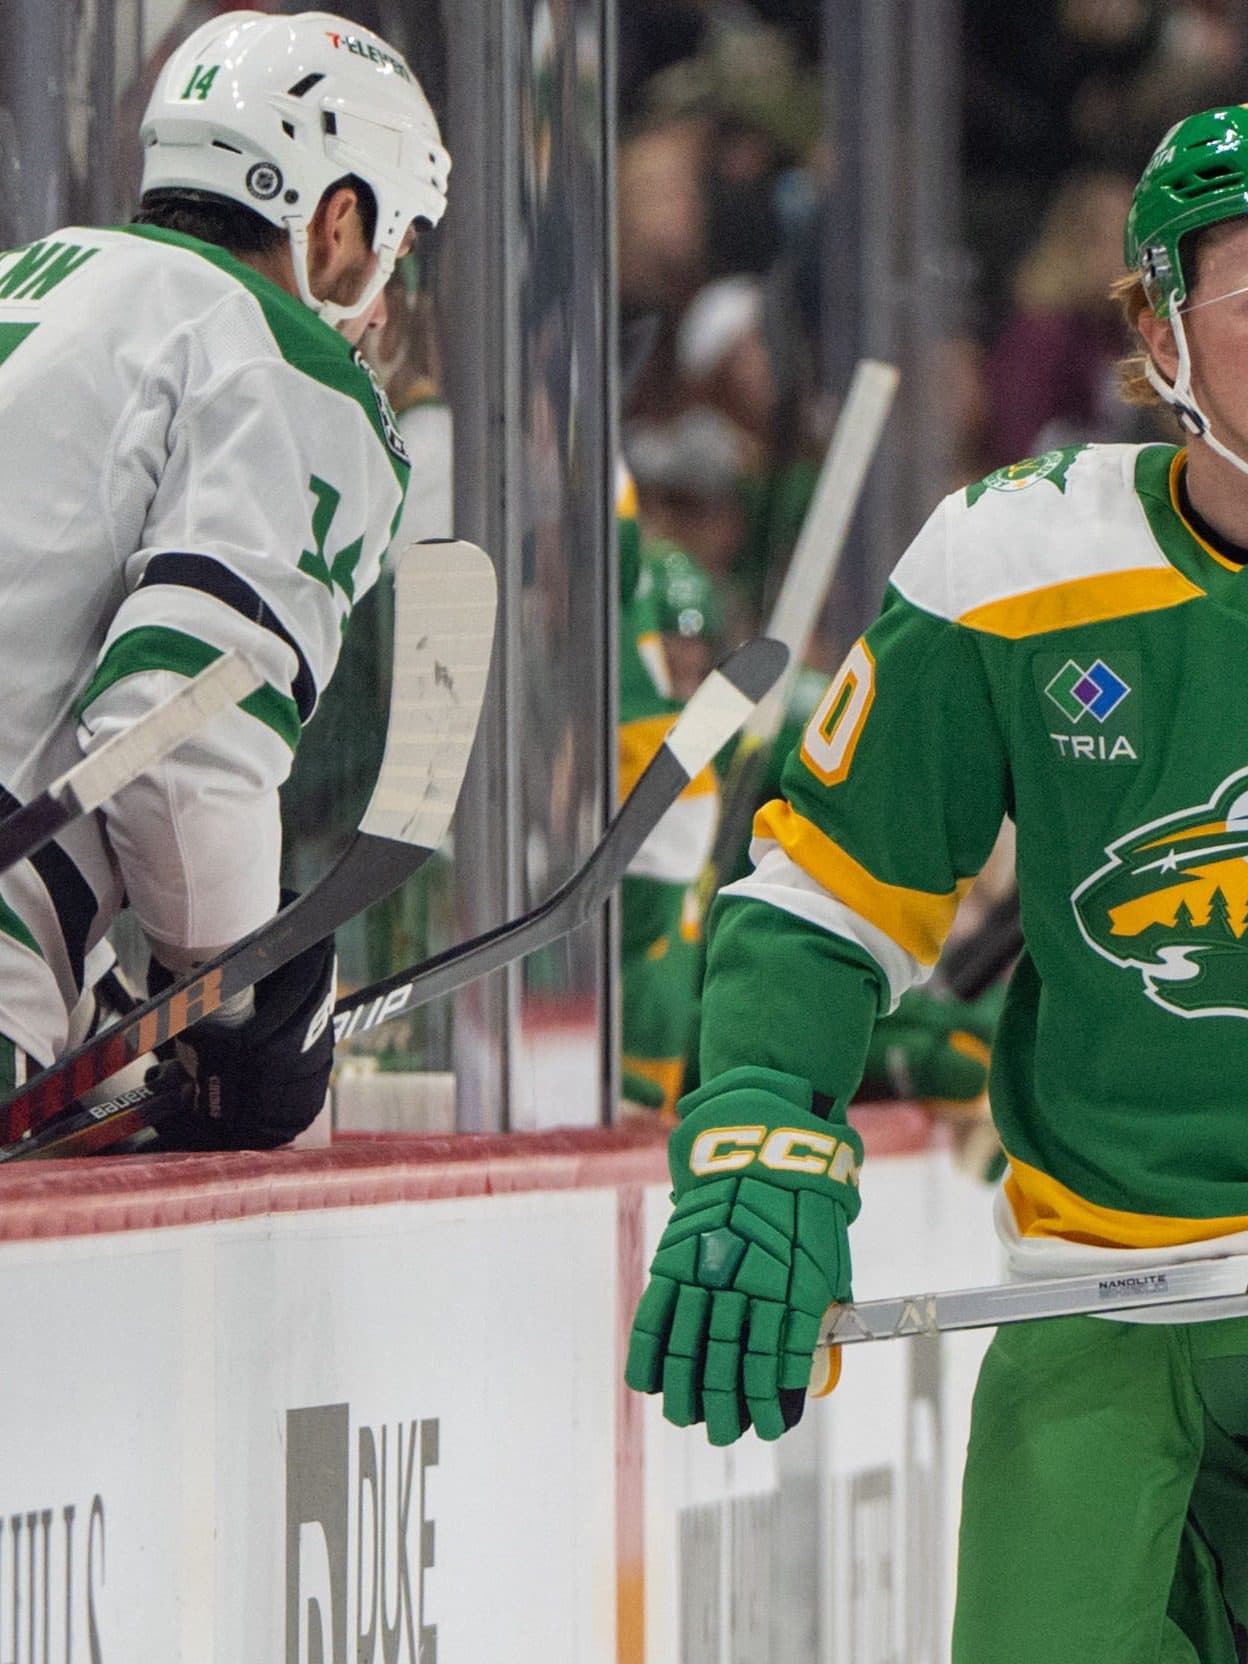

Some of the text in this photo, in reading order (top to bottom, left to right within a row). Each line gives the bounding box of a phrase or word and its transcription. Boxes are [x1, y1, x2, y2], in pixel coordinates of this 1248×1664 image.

[182, 64, 220, 100] 14
[0, 241, 101, 300] NN
[1050, 734, 1138, 760] TRIA
[1098, 1274, 1166, 1289] NANOLITE
[358, 1417, 439, 1664] DUKE
